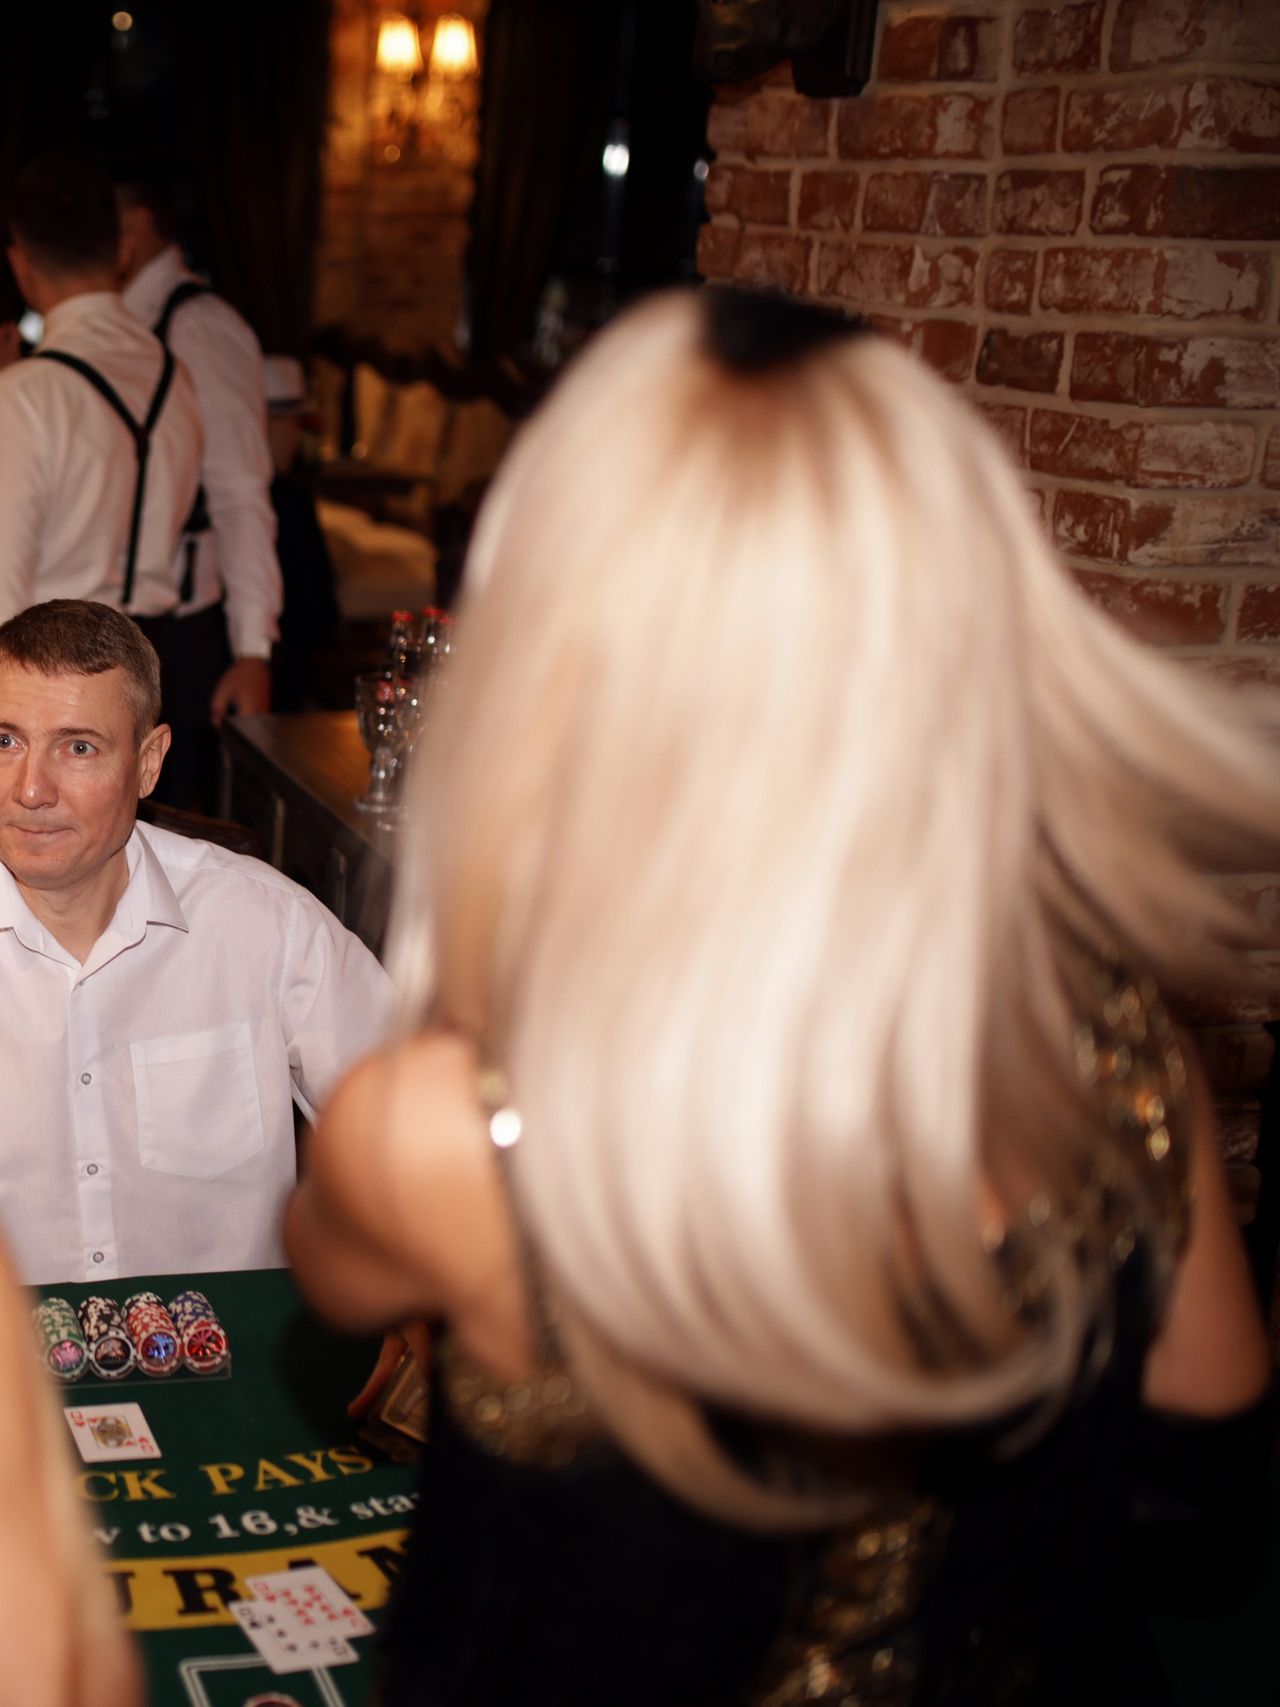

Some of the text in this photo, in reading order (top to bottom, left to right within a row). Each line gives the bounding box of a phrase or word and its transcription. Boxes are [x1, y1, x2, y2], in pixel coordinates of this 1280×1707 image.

[199, 1444, 374, 1497] PAYS
[136, 1521, 192, 1543] to
[350, 1492, 421, 1521] sta
